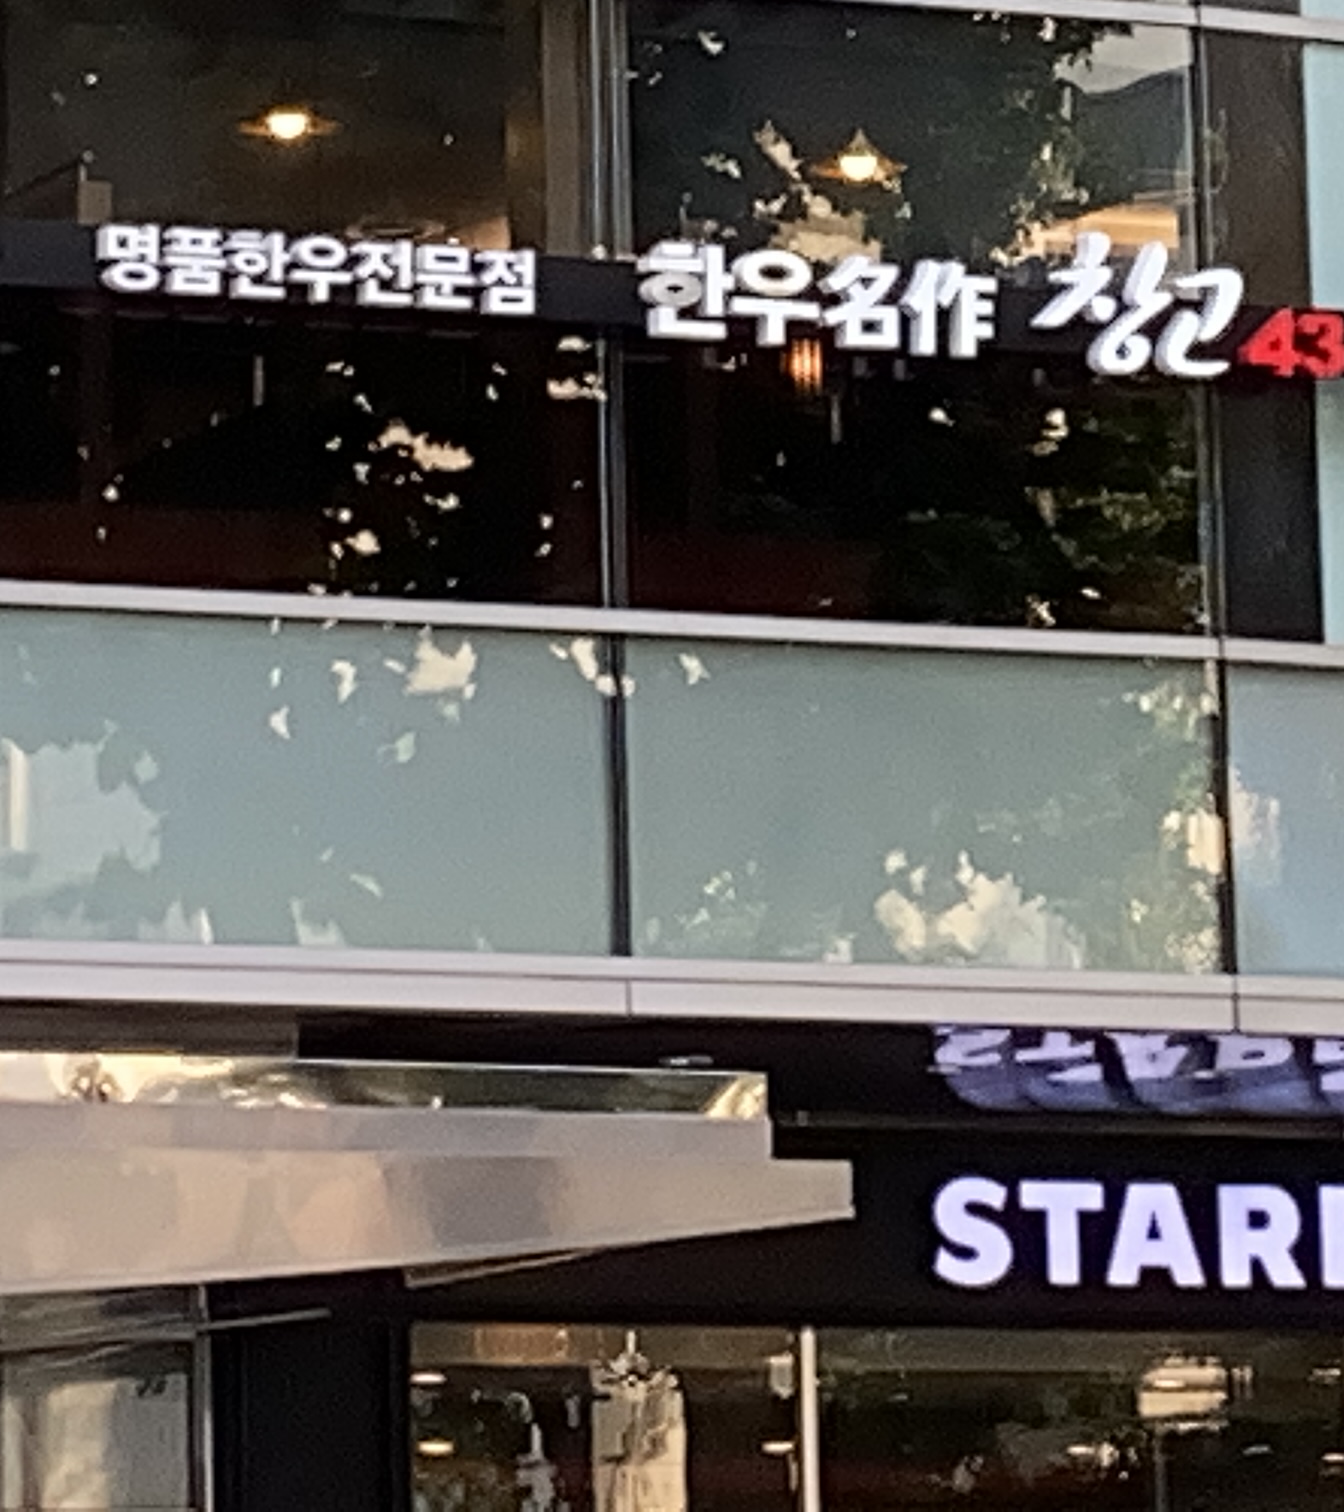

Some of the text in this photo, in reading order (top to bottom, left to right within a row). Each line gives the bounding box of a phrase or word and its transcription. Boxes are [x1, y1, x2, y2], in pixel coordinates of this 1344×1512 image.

[96, 223, 537, 316] 명품한우전문점
[636, 240, 997, 358] 한우名作
[1029, 231, 1244, 378] 창고
